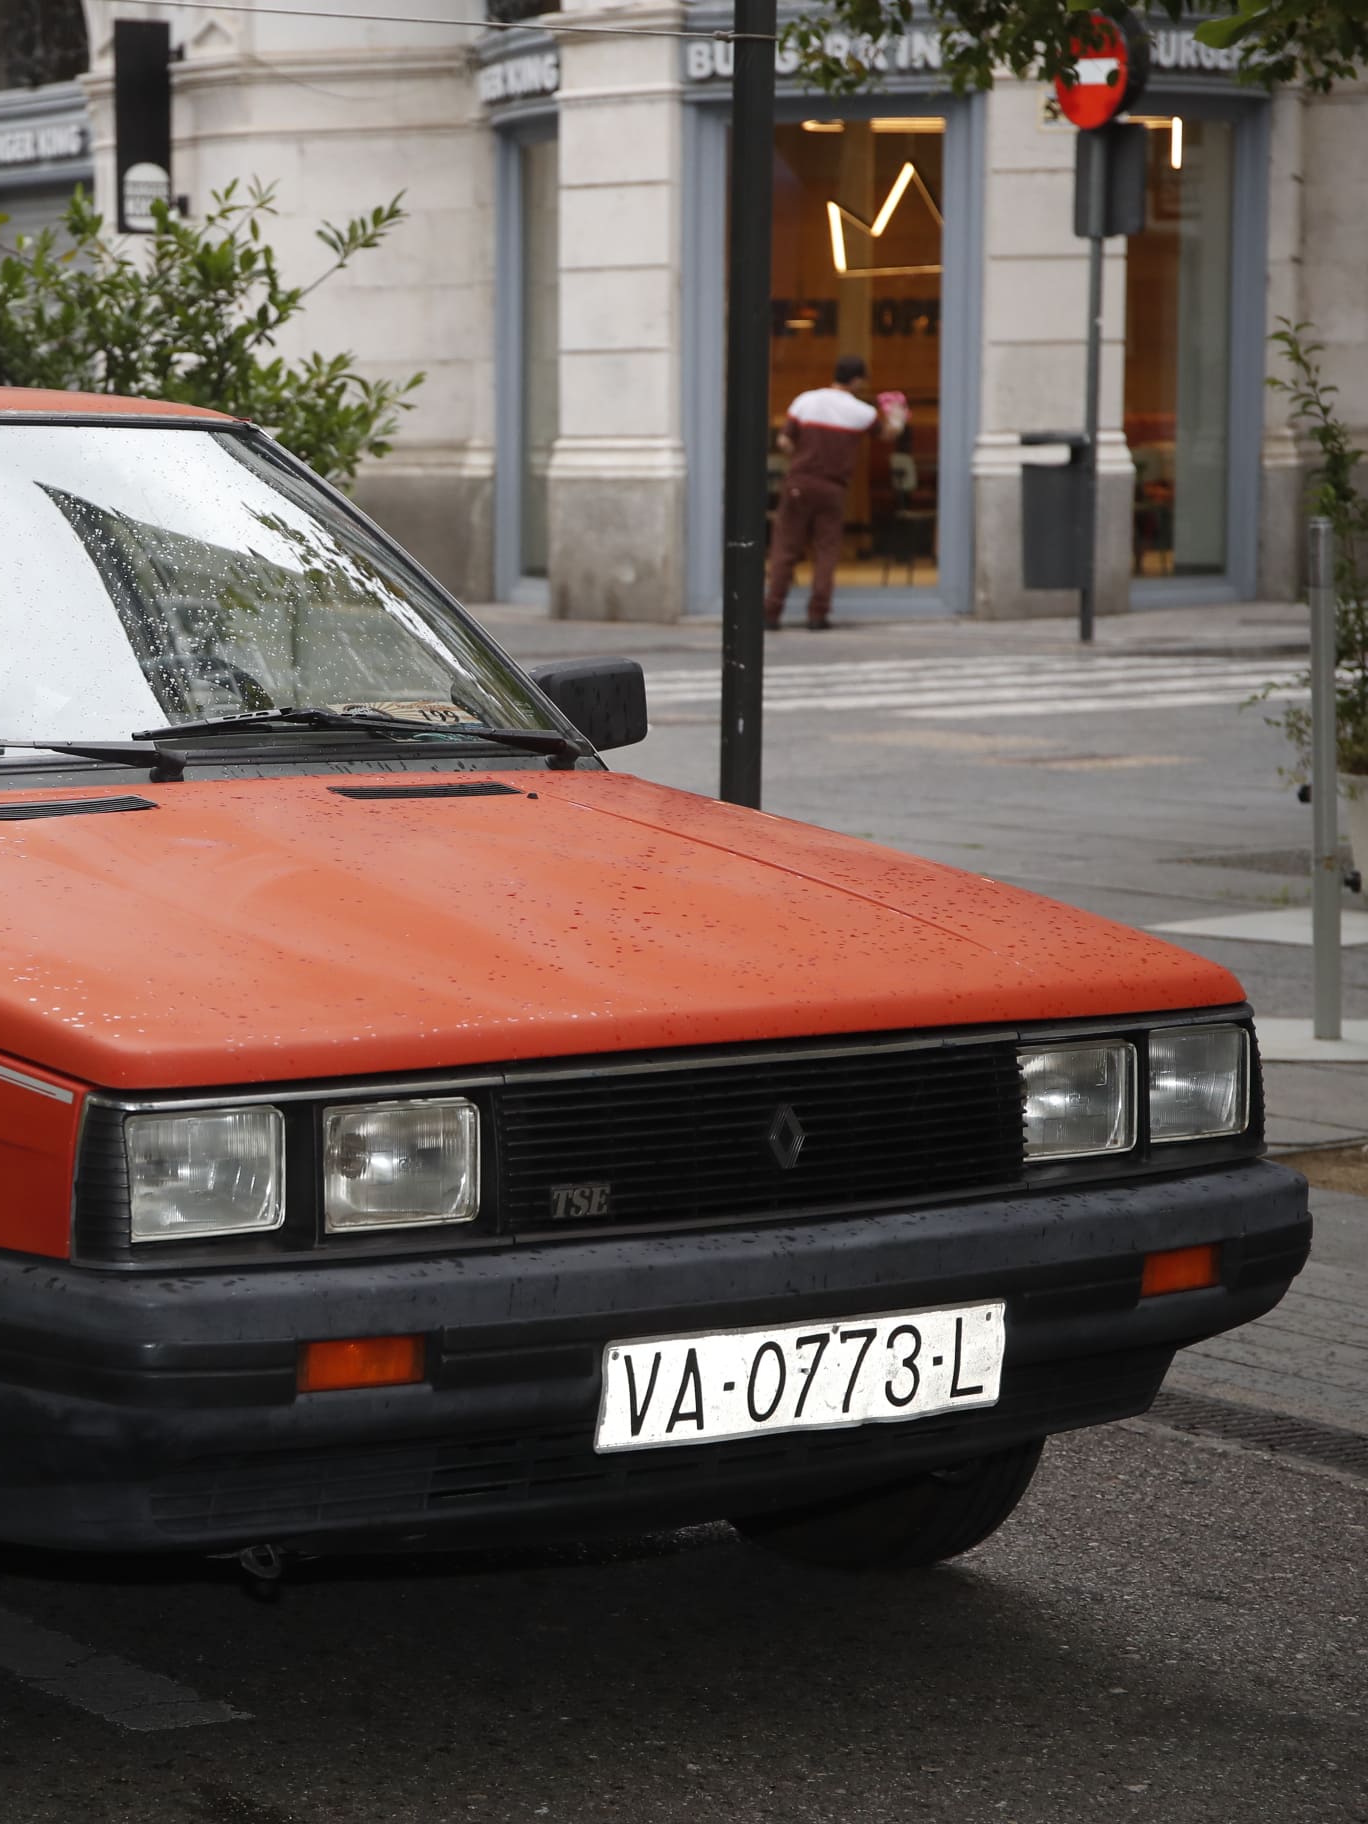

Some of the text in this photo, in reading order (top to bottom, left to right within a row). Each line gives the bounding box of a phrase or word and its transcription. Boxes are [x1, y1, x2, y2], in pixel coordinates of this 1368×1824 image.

[507, 53, 557, 94] KING
[38, 124, 82, 158] KING
[552, 1187, 610, 1218] TSE
